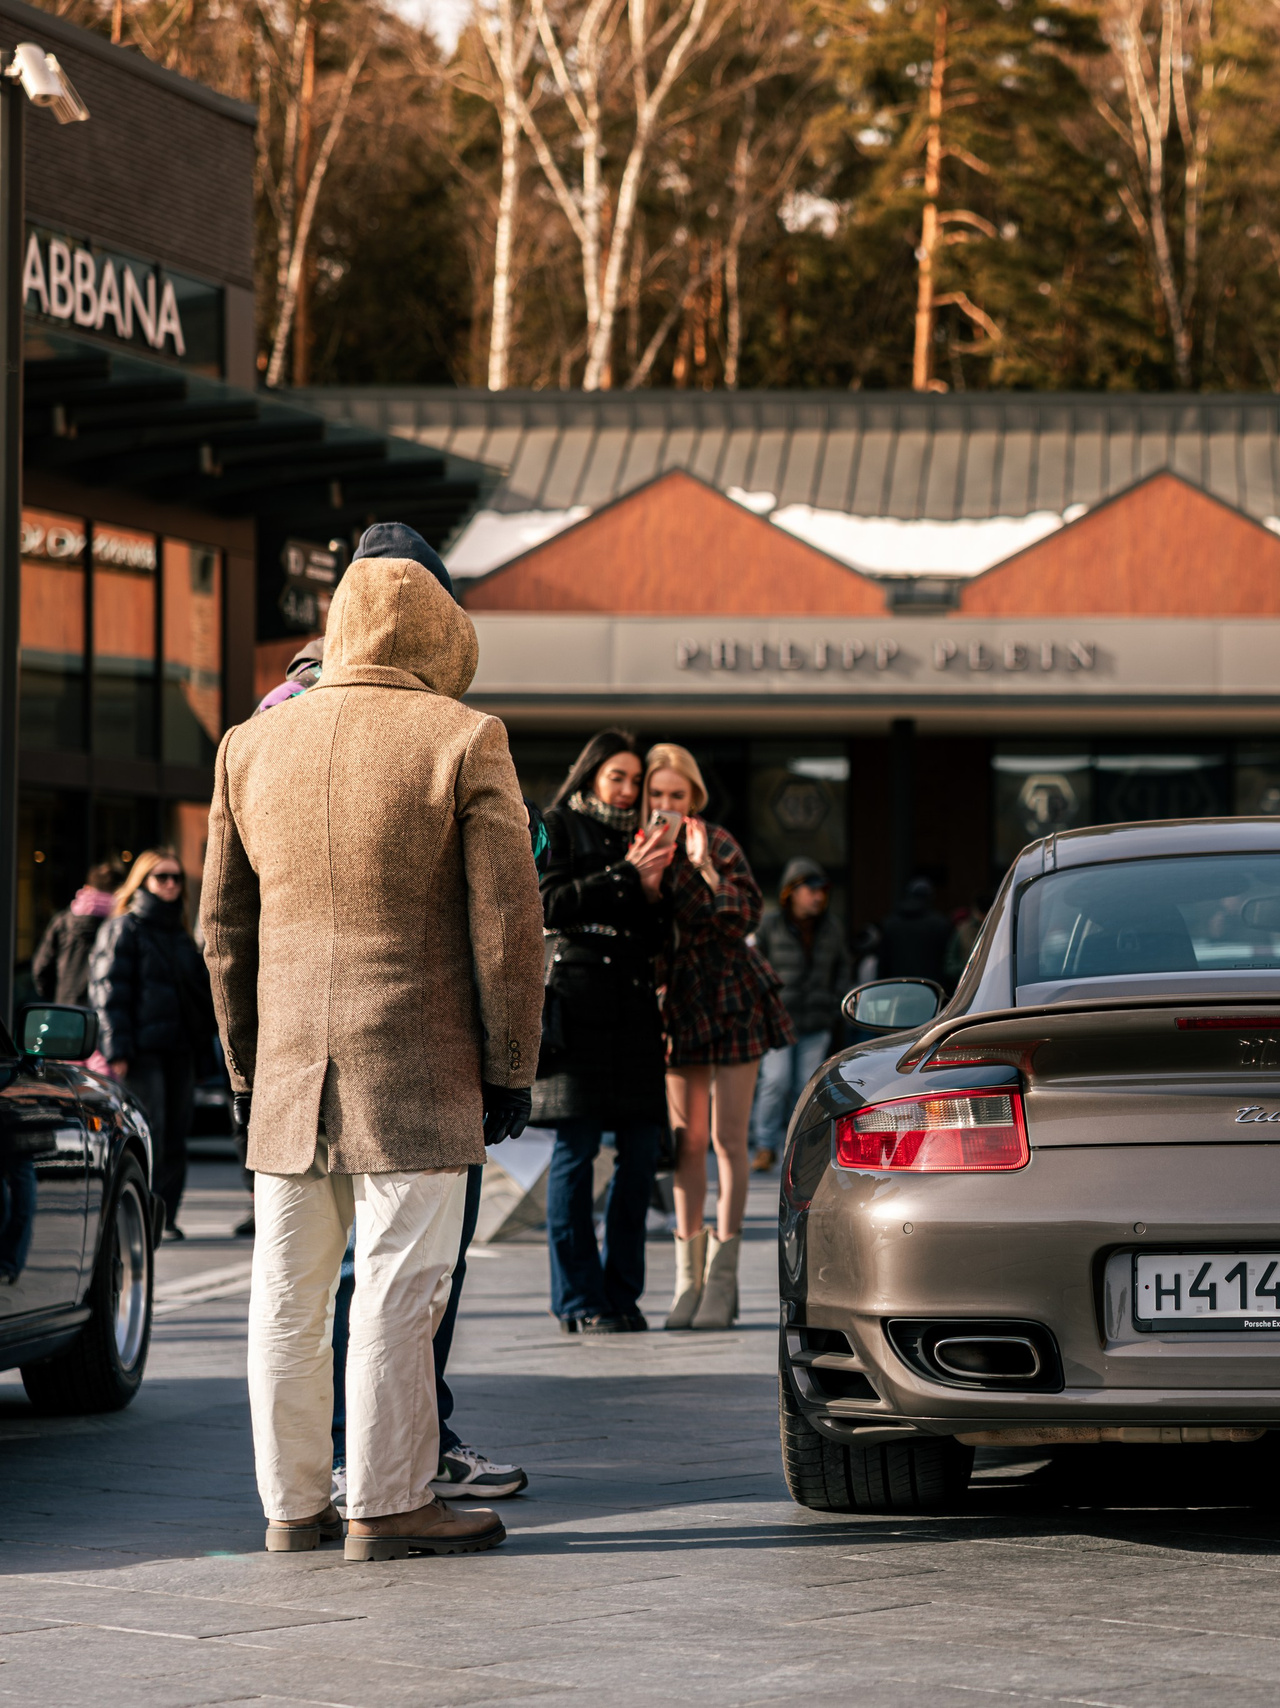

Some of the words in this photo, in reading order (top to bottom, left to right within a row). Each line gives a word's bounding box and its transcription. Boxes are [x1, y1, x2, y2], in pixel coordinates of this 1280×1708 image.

[23, 232, 186, 356] ABBANA
[677, 638, 899, 670] PHILIPP
[934, 638, 1096, 670] PLEIN
